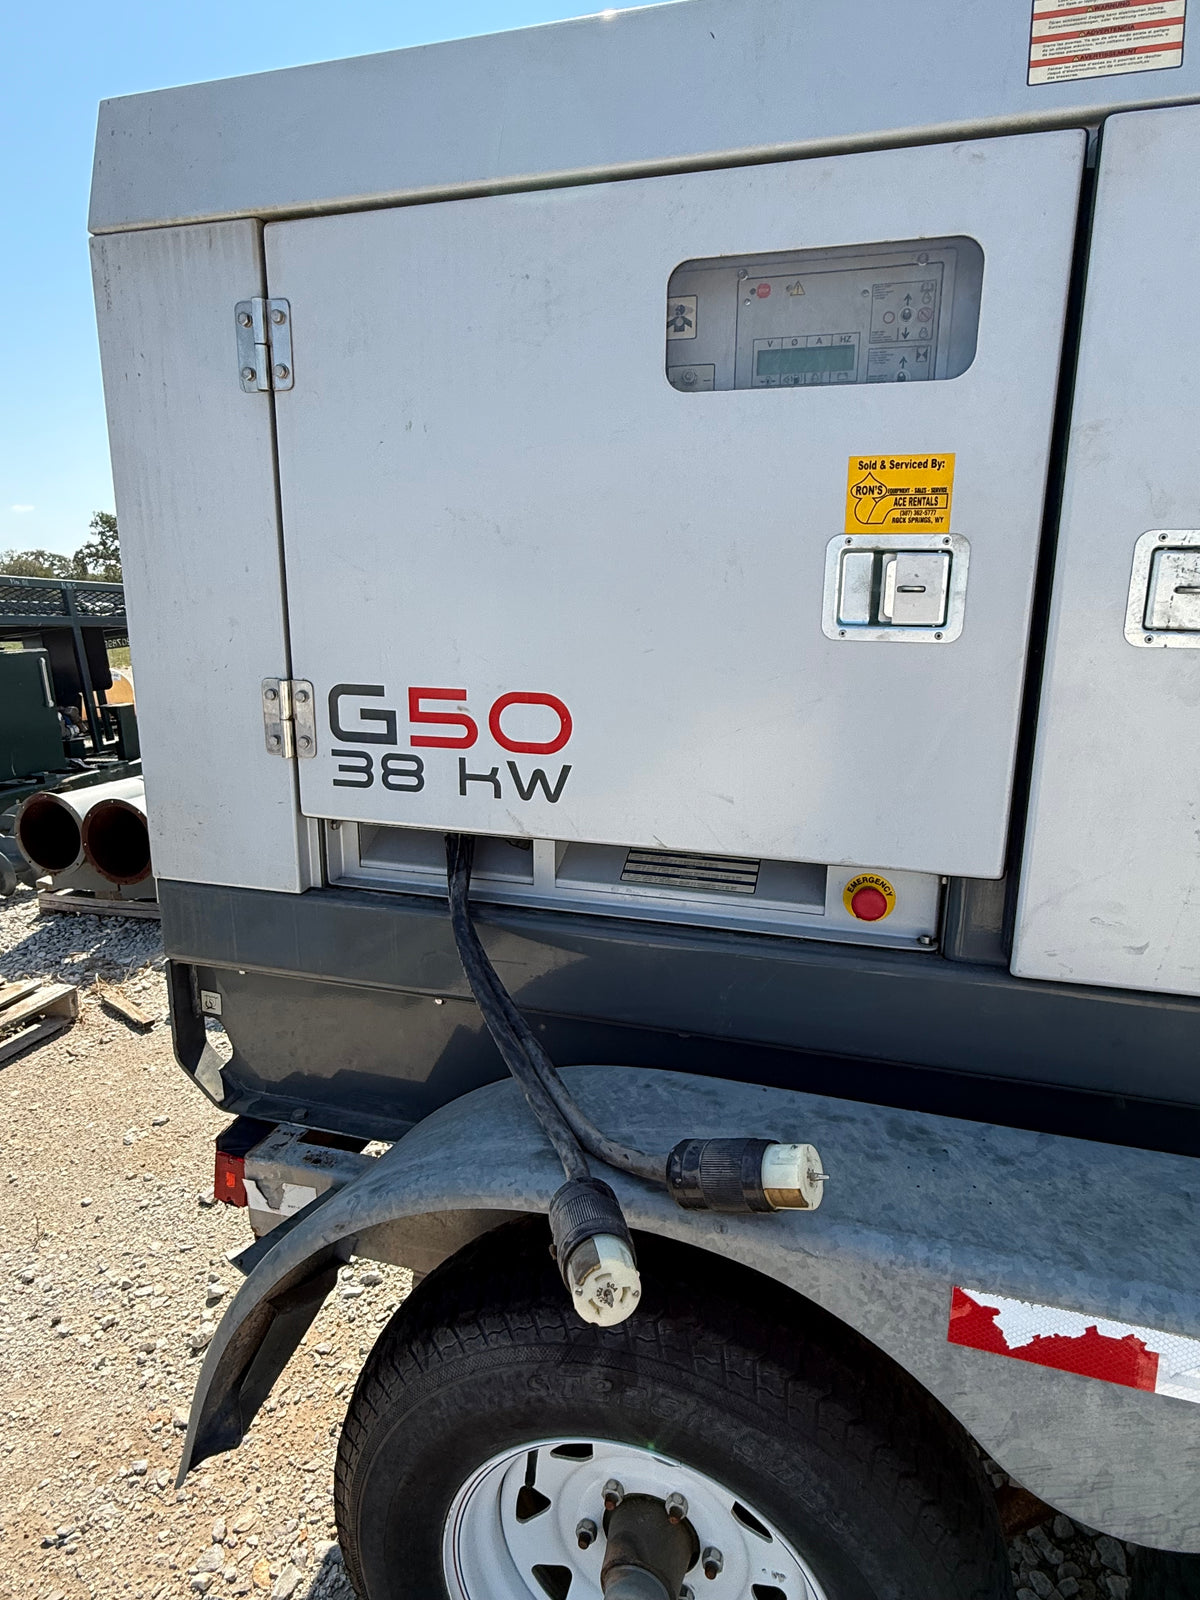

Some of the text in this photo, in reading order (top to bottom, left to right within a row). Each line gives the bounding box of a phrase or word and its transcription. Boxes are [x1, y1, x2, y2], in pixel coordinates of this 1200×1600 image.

[1086, 24, 1135, 36] ADVERTENCIA
[1080, 48, 1138, 61] AVERTISSEMENT
[767, 340, 773, 348] V
[858, 458, 945, 471] Sold & Serviced By:
[856, 485, 883, 495] RON'S
[893, 496, 939, 507] ACE RENTALS
[908, 516, 933, 524] SPRINGS,
[328, 683, 573, 755] G50
[331, 749, 424, 793] 38
[847, 876, 893, 896] EMERGENCY
